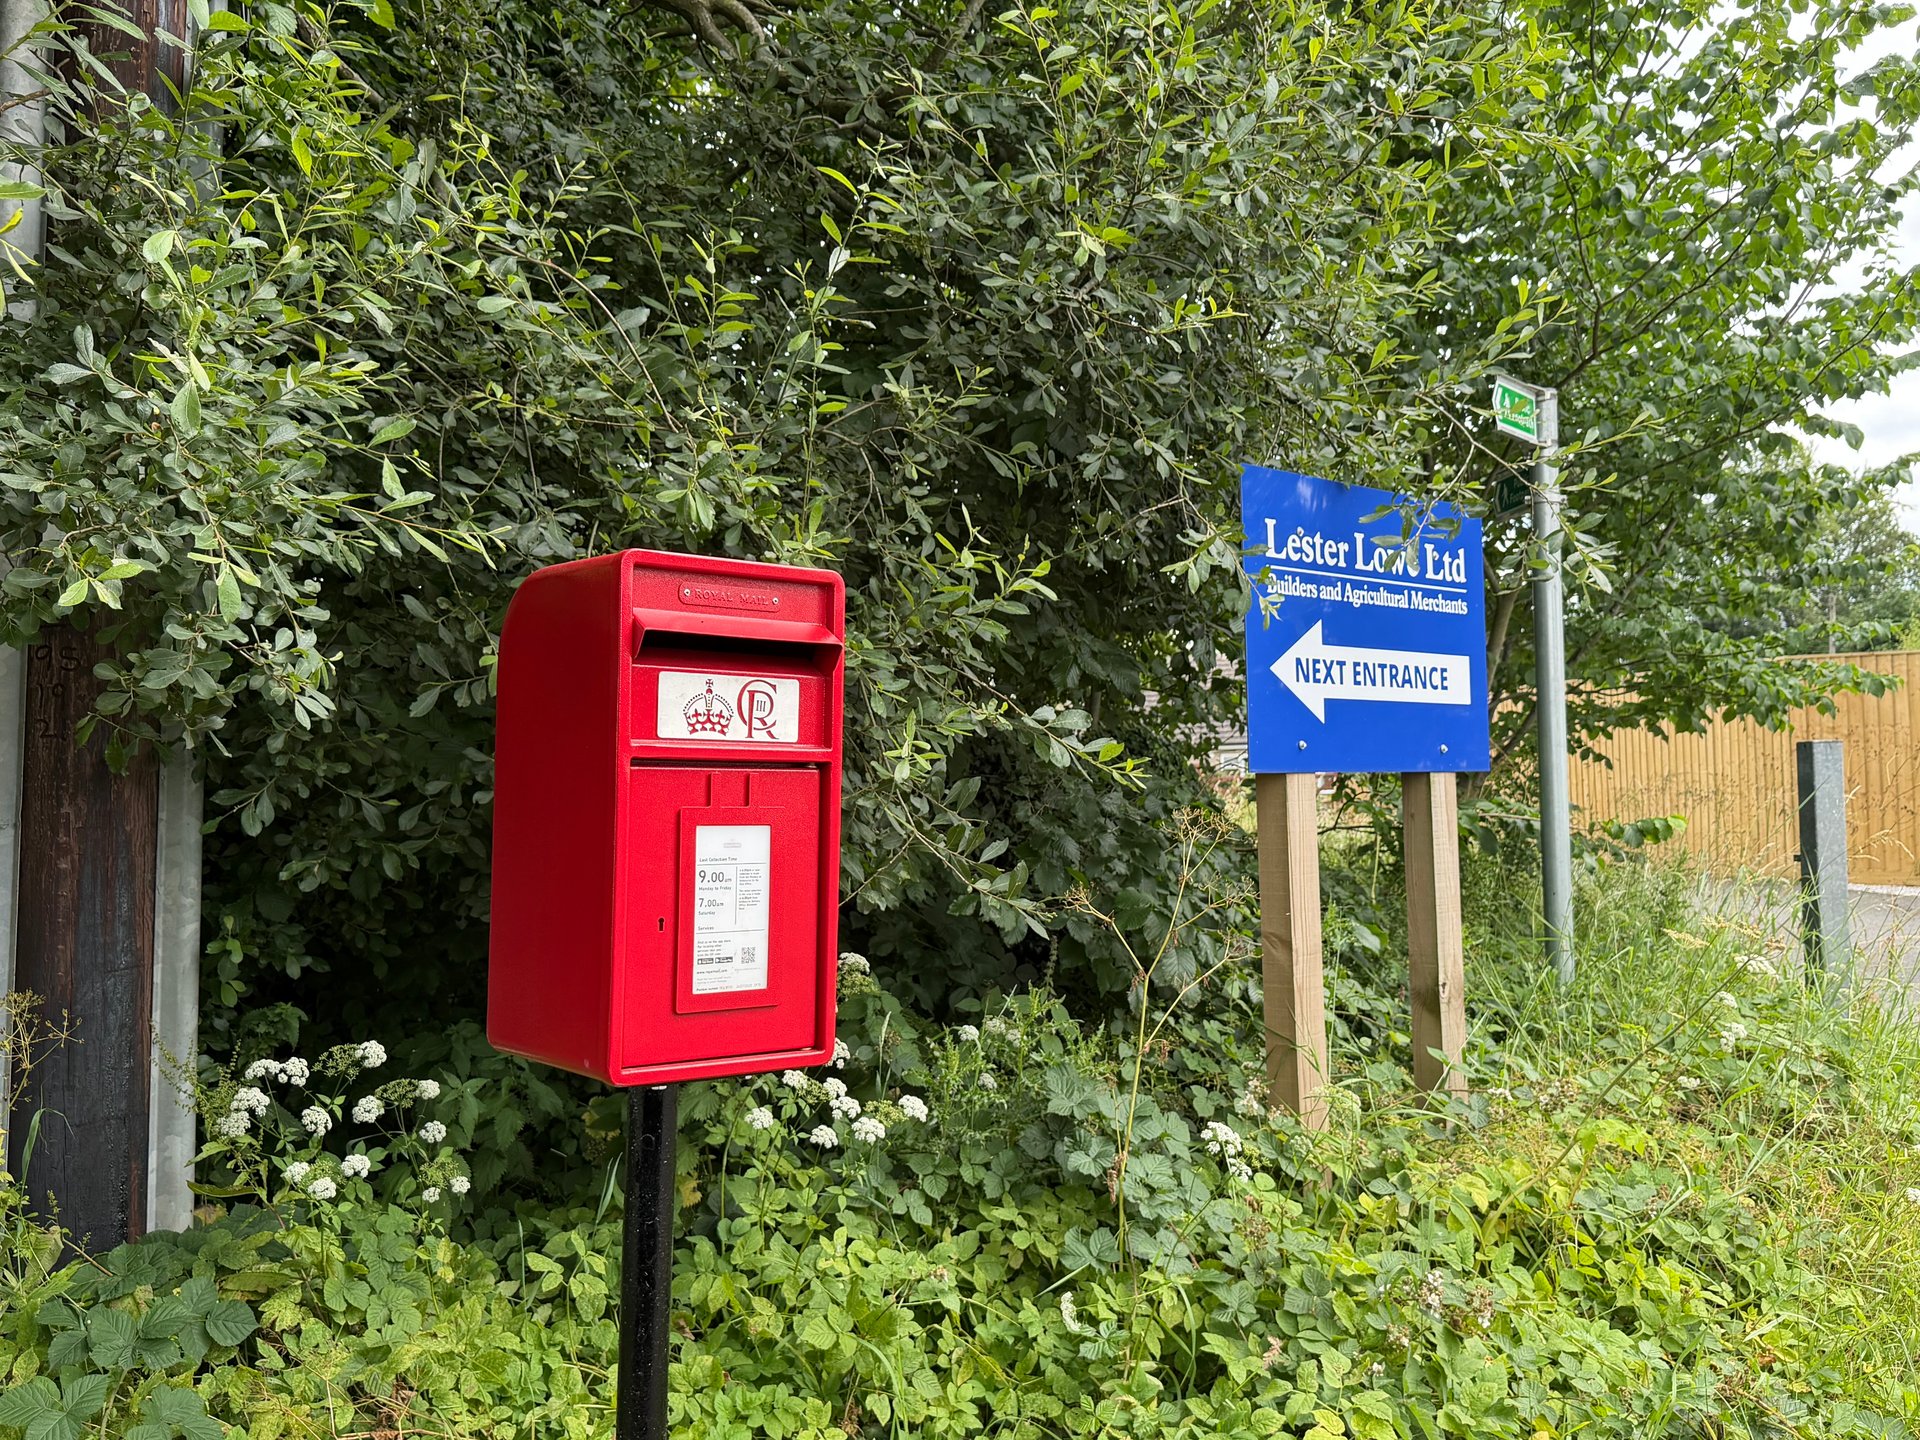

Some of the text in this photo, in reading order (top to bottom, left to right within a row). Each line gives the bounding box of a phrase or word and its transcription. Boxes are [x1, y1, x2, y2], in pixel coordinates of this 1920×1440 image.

[1265, 518, 1349, 567] Lester
[1424, 544, 1467, 583] Ltd
[694, 588, 769, 606] ROYAL MAIL
[1267, 573, 1468, 615] Builders and Agricultural Merchants
[1295, 657, 1448, 690] NEXT ENTRANCE
